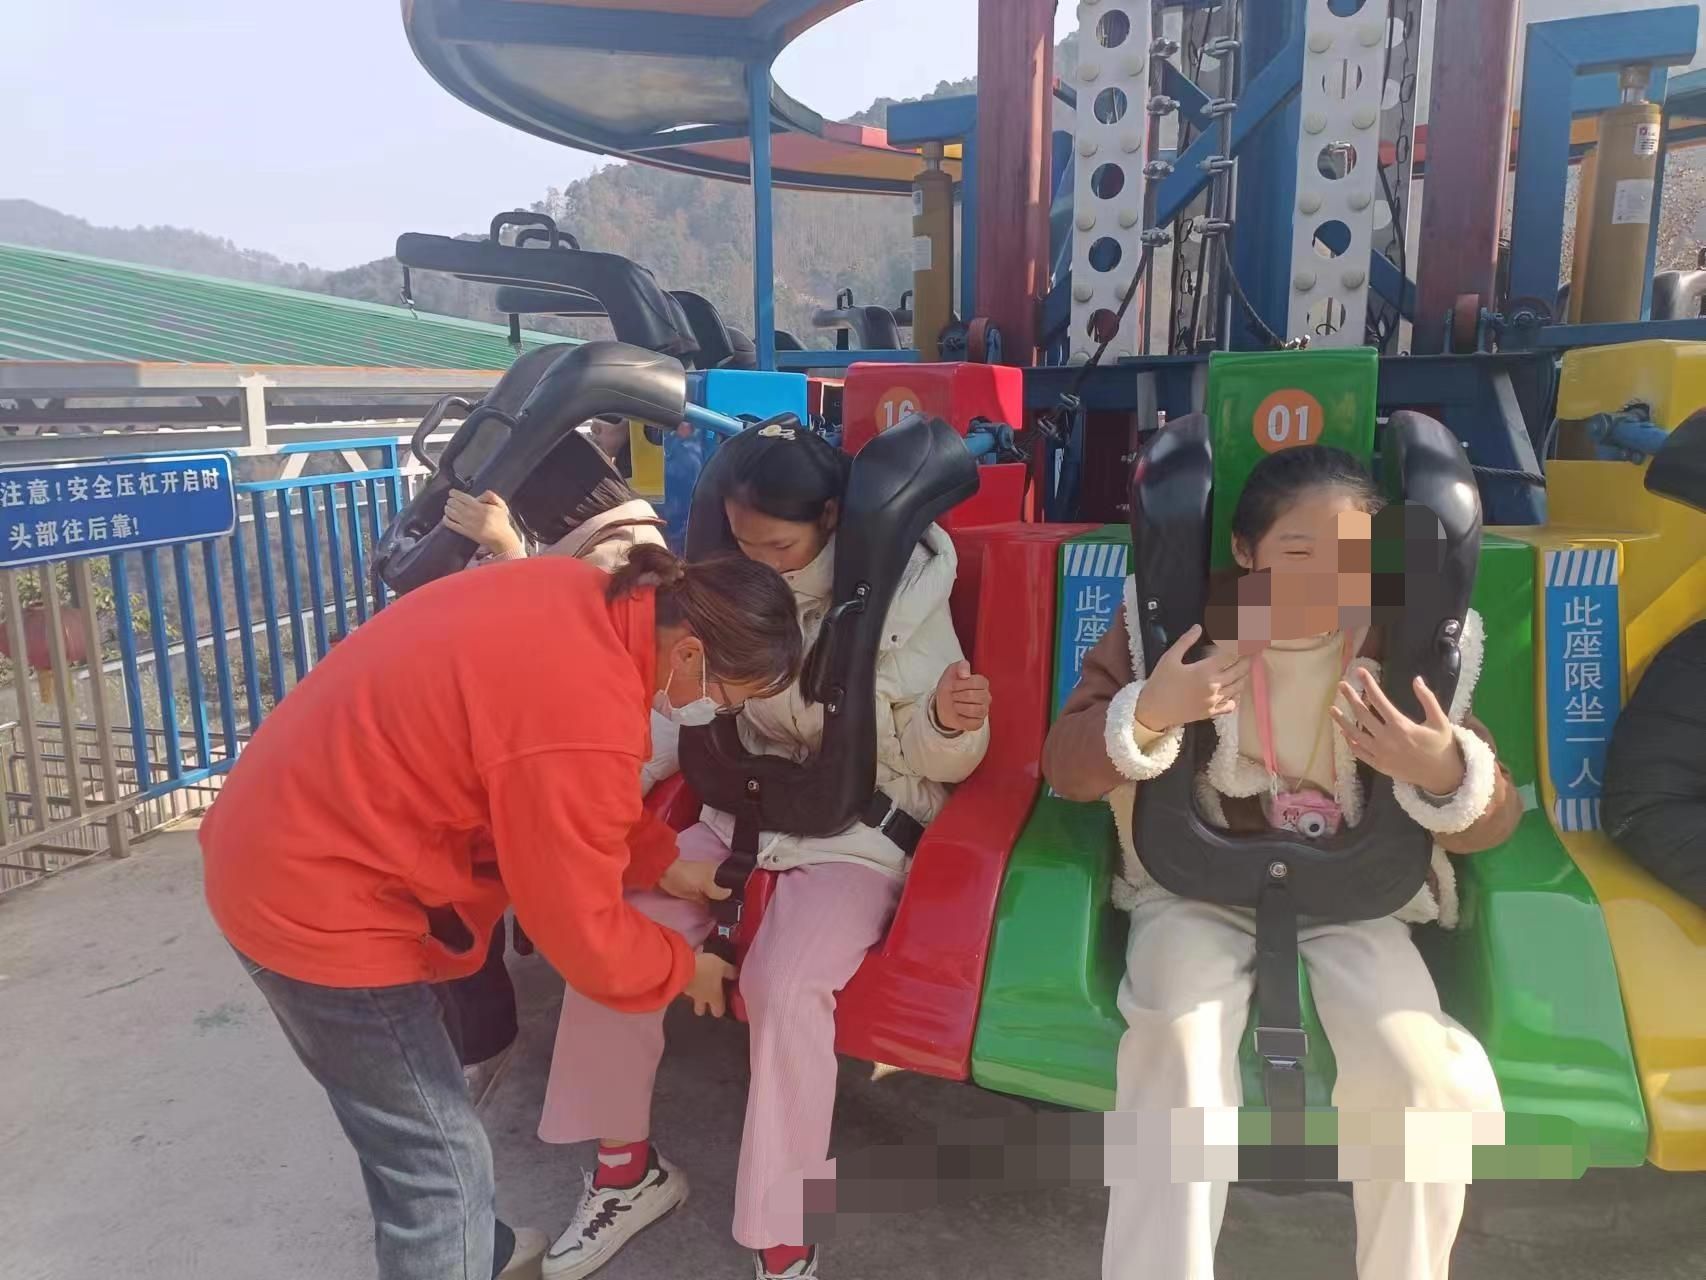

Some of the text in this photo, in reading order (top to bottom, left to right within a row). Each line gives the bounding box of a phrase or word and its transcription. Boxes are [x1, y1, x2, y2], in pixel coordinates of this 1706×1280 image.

[1268, 404, 1309, 442] 01
[0, 468, 219, 507] 注意!安全压杠开启时
[9, 513, 139, 550] 头部往后靠!
[1562, 596, 1605, 788] 此座限坐一人
